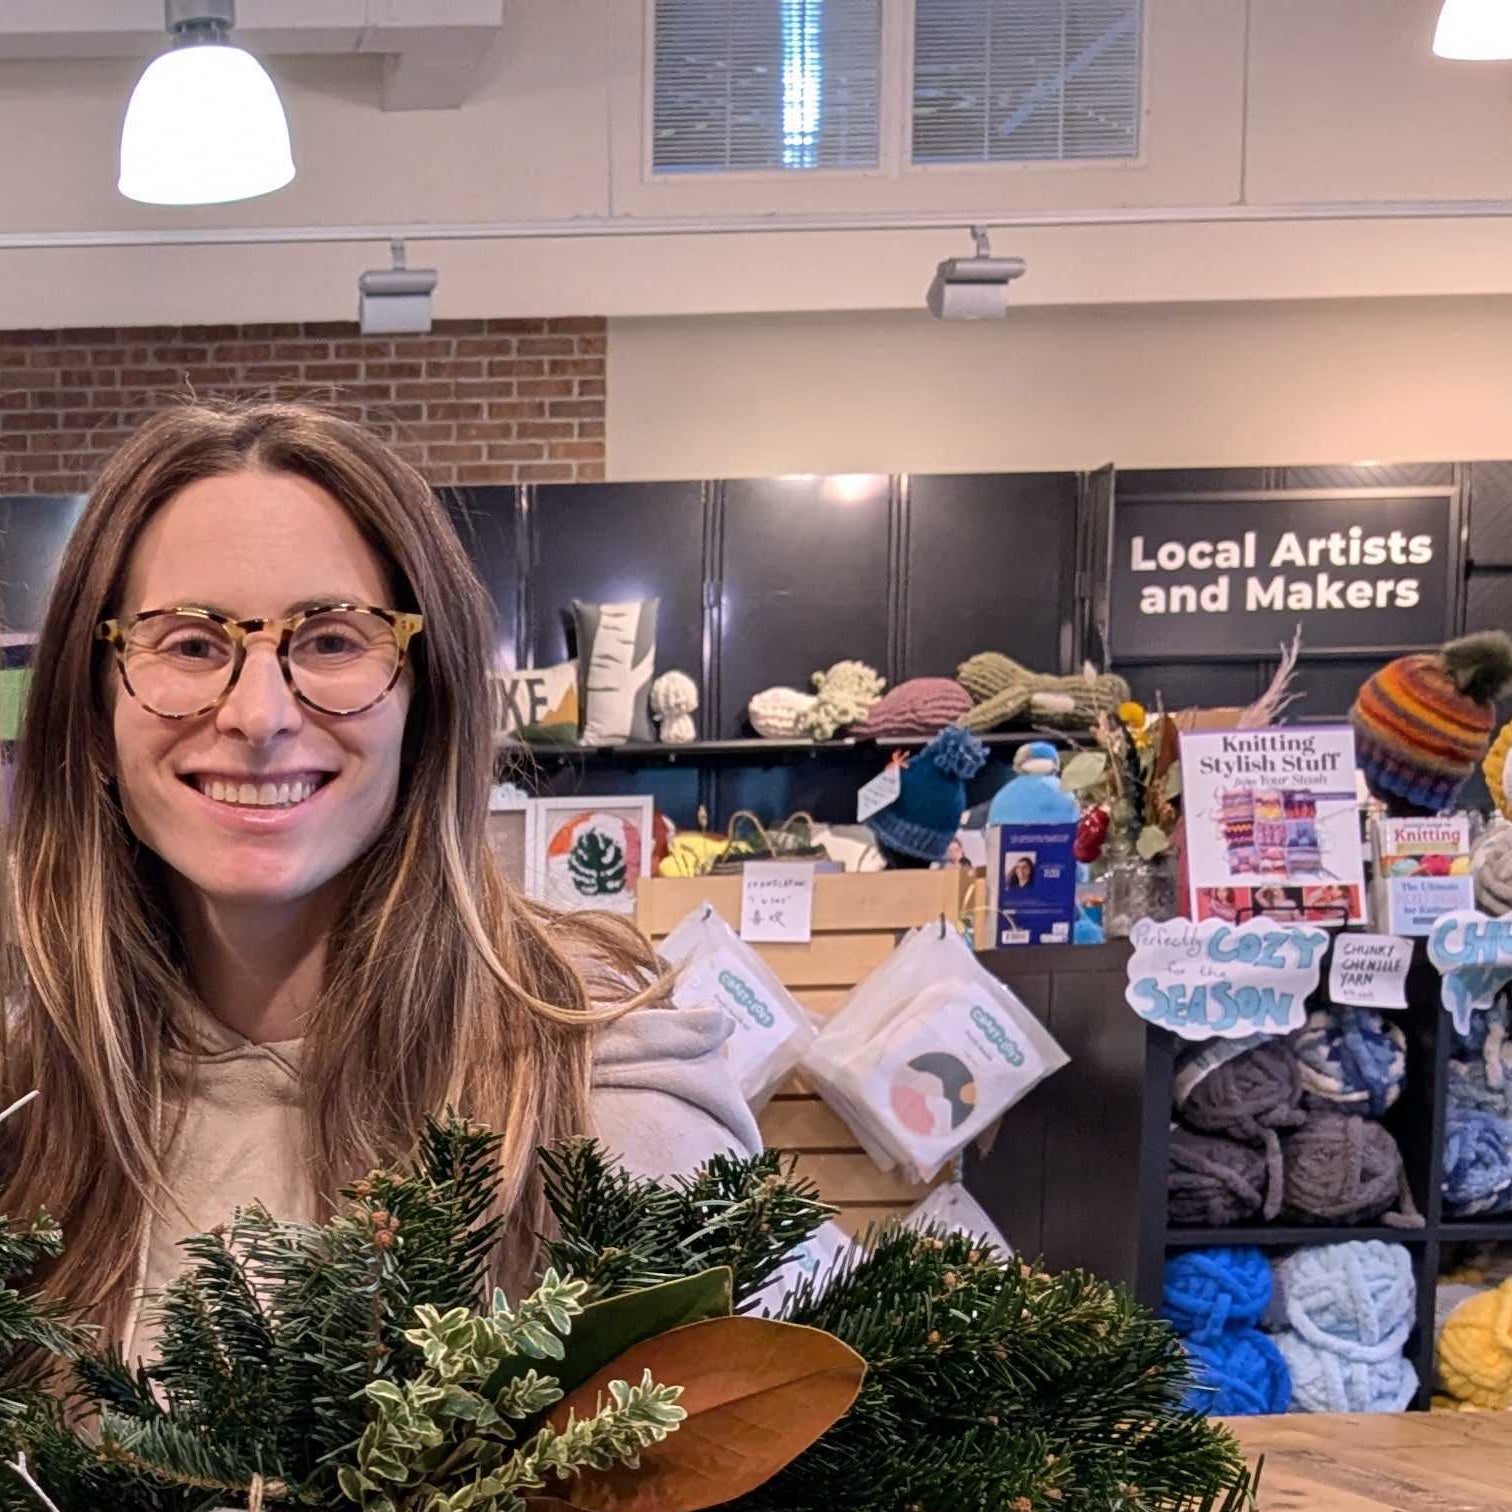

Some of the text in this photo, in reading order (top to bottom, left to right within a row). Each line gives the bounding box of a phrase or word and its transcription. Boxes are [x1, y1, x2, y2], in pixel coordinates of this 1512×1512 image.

[1131, 526, 1433, 571] Local Artists
[1140, 572, 1420, 614] and Makers
[1223, 735, 1315, 756] Knitting
[1200, 752, 1340, 777] Stylish Stuff
[1260, 775, 1288, 786] Your
[1395, 829, 1461, 845] Knitting
[1138, 924, 1327, 969] Perfectly COZY
[1343, 943, 1395, 957] CHUNKY
[1161, 961, 1227, 977] for the
[1341, 959, 1401, 973] CHENILLE
[1340, 973, 1374, 987] YARN
[1134, 978, 1294, 1030] SEASON
